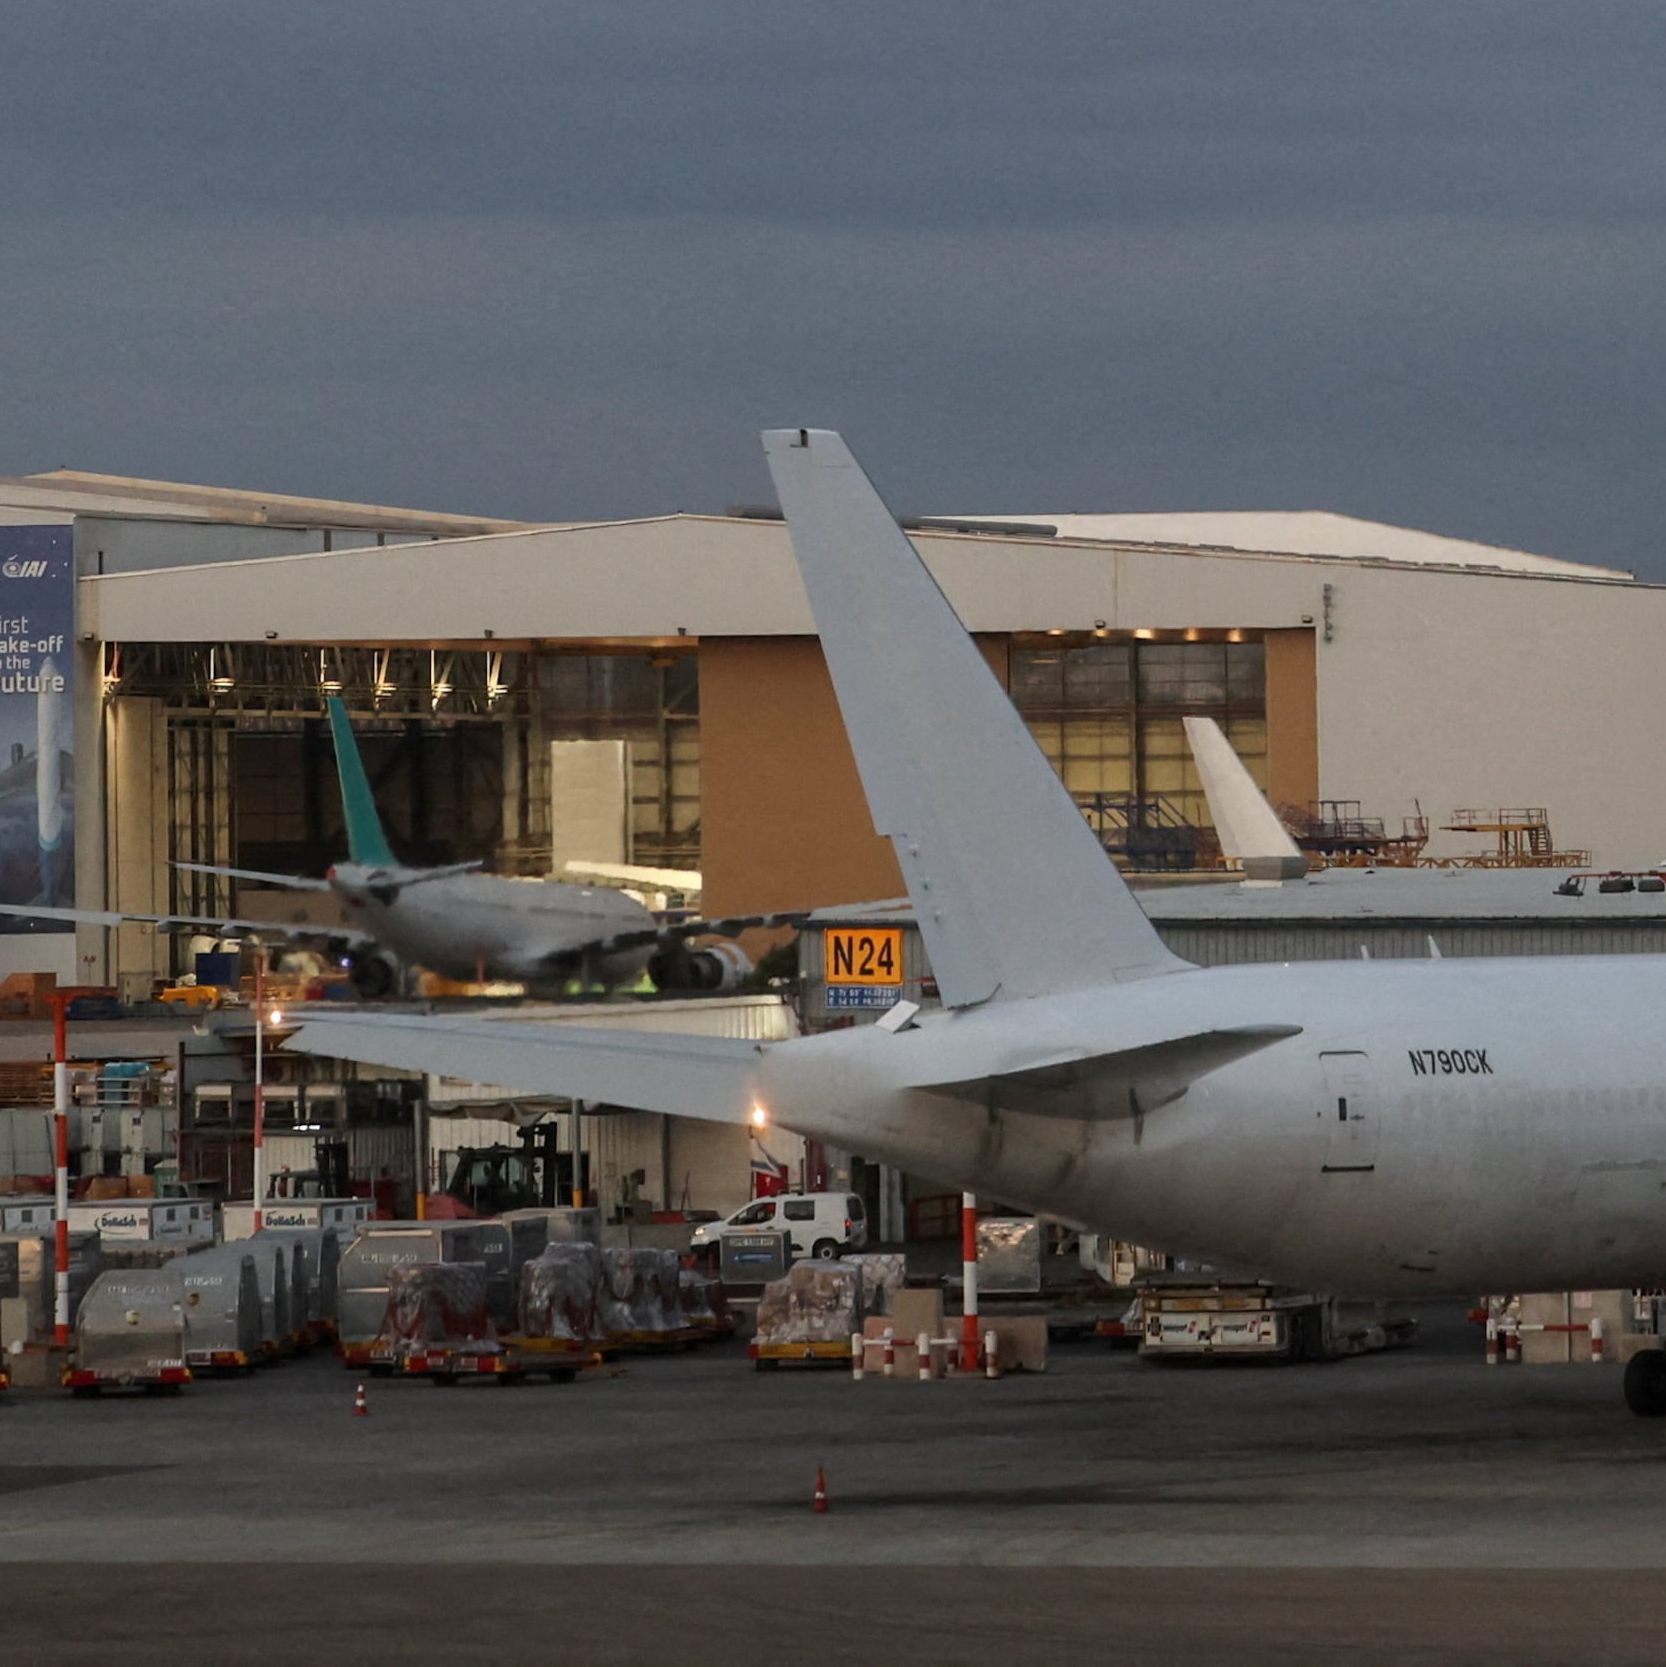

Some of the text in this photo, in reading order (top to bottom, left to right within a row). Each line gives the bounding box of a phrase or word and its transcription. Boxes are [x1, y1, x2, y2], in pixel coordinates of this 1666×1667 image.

[6, 655, 31, 670] the
[833, 935, 894, 976] N24
[1408, 1048, 1494, 1075] N790CK
